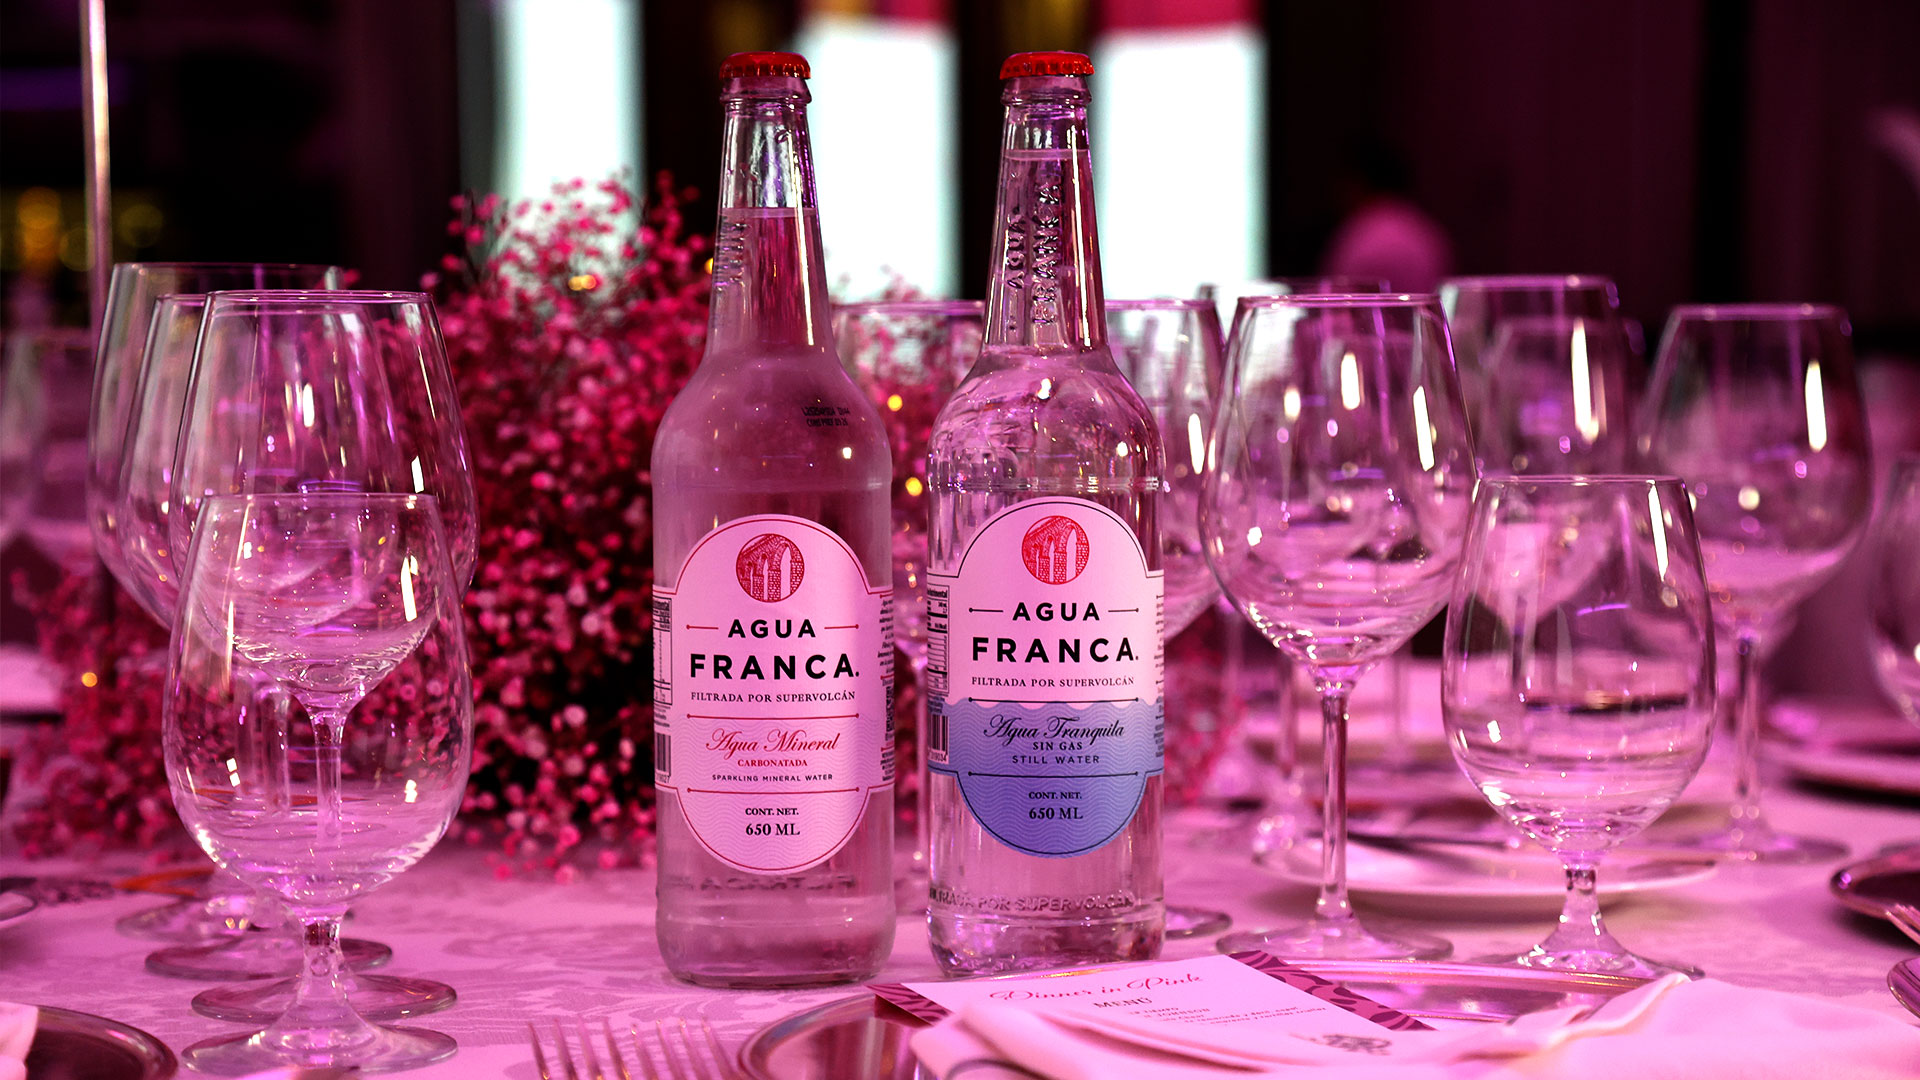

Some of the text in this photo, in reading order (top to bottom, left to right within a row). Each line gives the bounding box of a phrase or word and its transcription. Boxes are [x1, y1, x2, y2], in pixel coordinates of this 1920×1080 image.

[1012, 601, 1100, 622] AGUA
[727, 618, 816, 639] AGUA
[972, 636, 1139, 664] FRANCA.
[690, 653, 860, 680] FRANCA.
[971, 675, 1134, 688] FILTRADA POR SUPERVOLCÁN
[691, 689, 855, 703] FILTRADA POR SUPERVOLCÁN
[983, 714, 1040, 746] Agua
[1043, 715, 1126, 746] Tranquila
[705, 727, 841, 761] Agua Mineral
[1032, 741, 1083, 751] SIN GAS
[737, 759, 808, 767] CARBONATADA
[1012, 754, 1100, 765] STILL WATER
[712, 774, 759, 782] SPARKLING
[804, 773, 833, 782] WATER
[1028, 791, 1083, 800] CONT. NET.
[744, 807, 798, 816] CONT. NET.
[1028, 806, 1084, 820] 650 ML
[745, 823, 801, 836] 650 ML
[990, 973, 1201, 1001] Dinner in Pink
